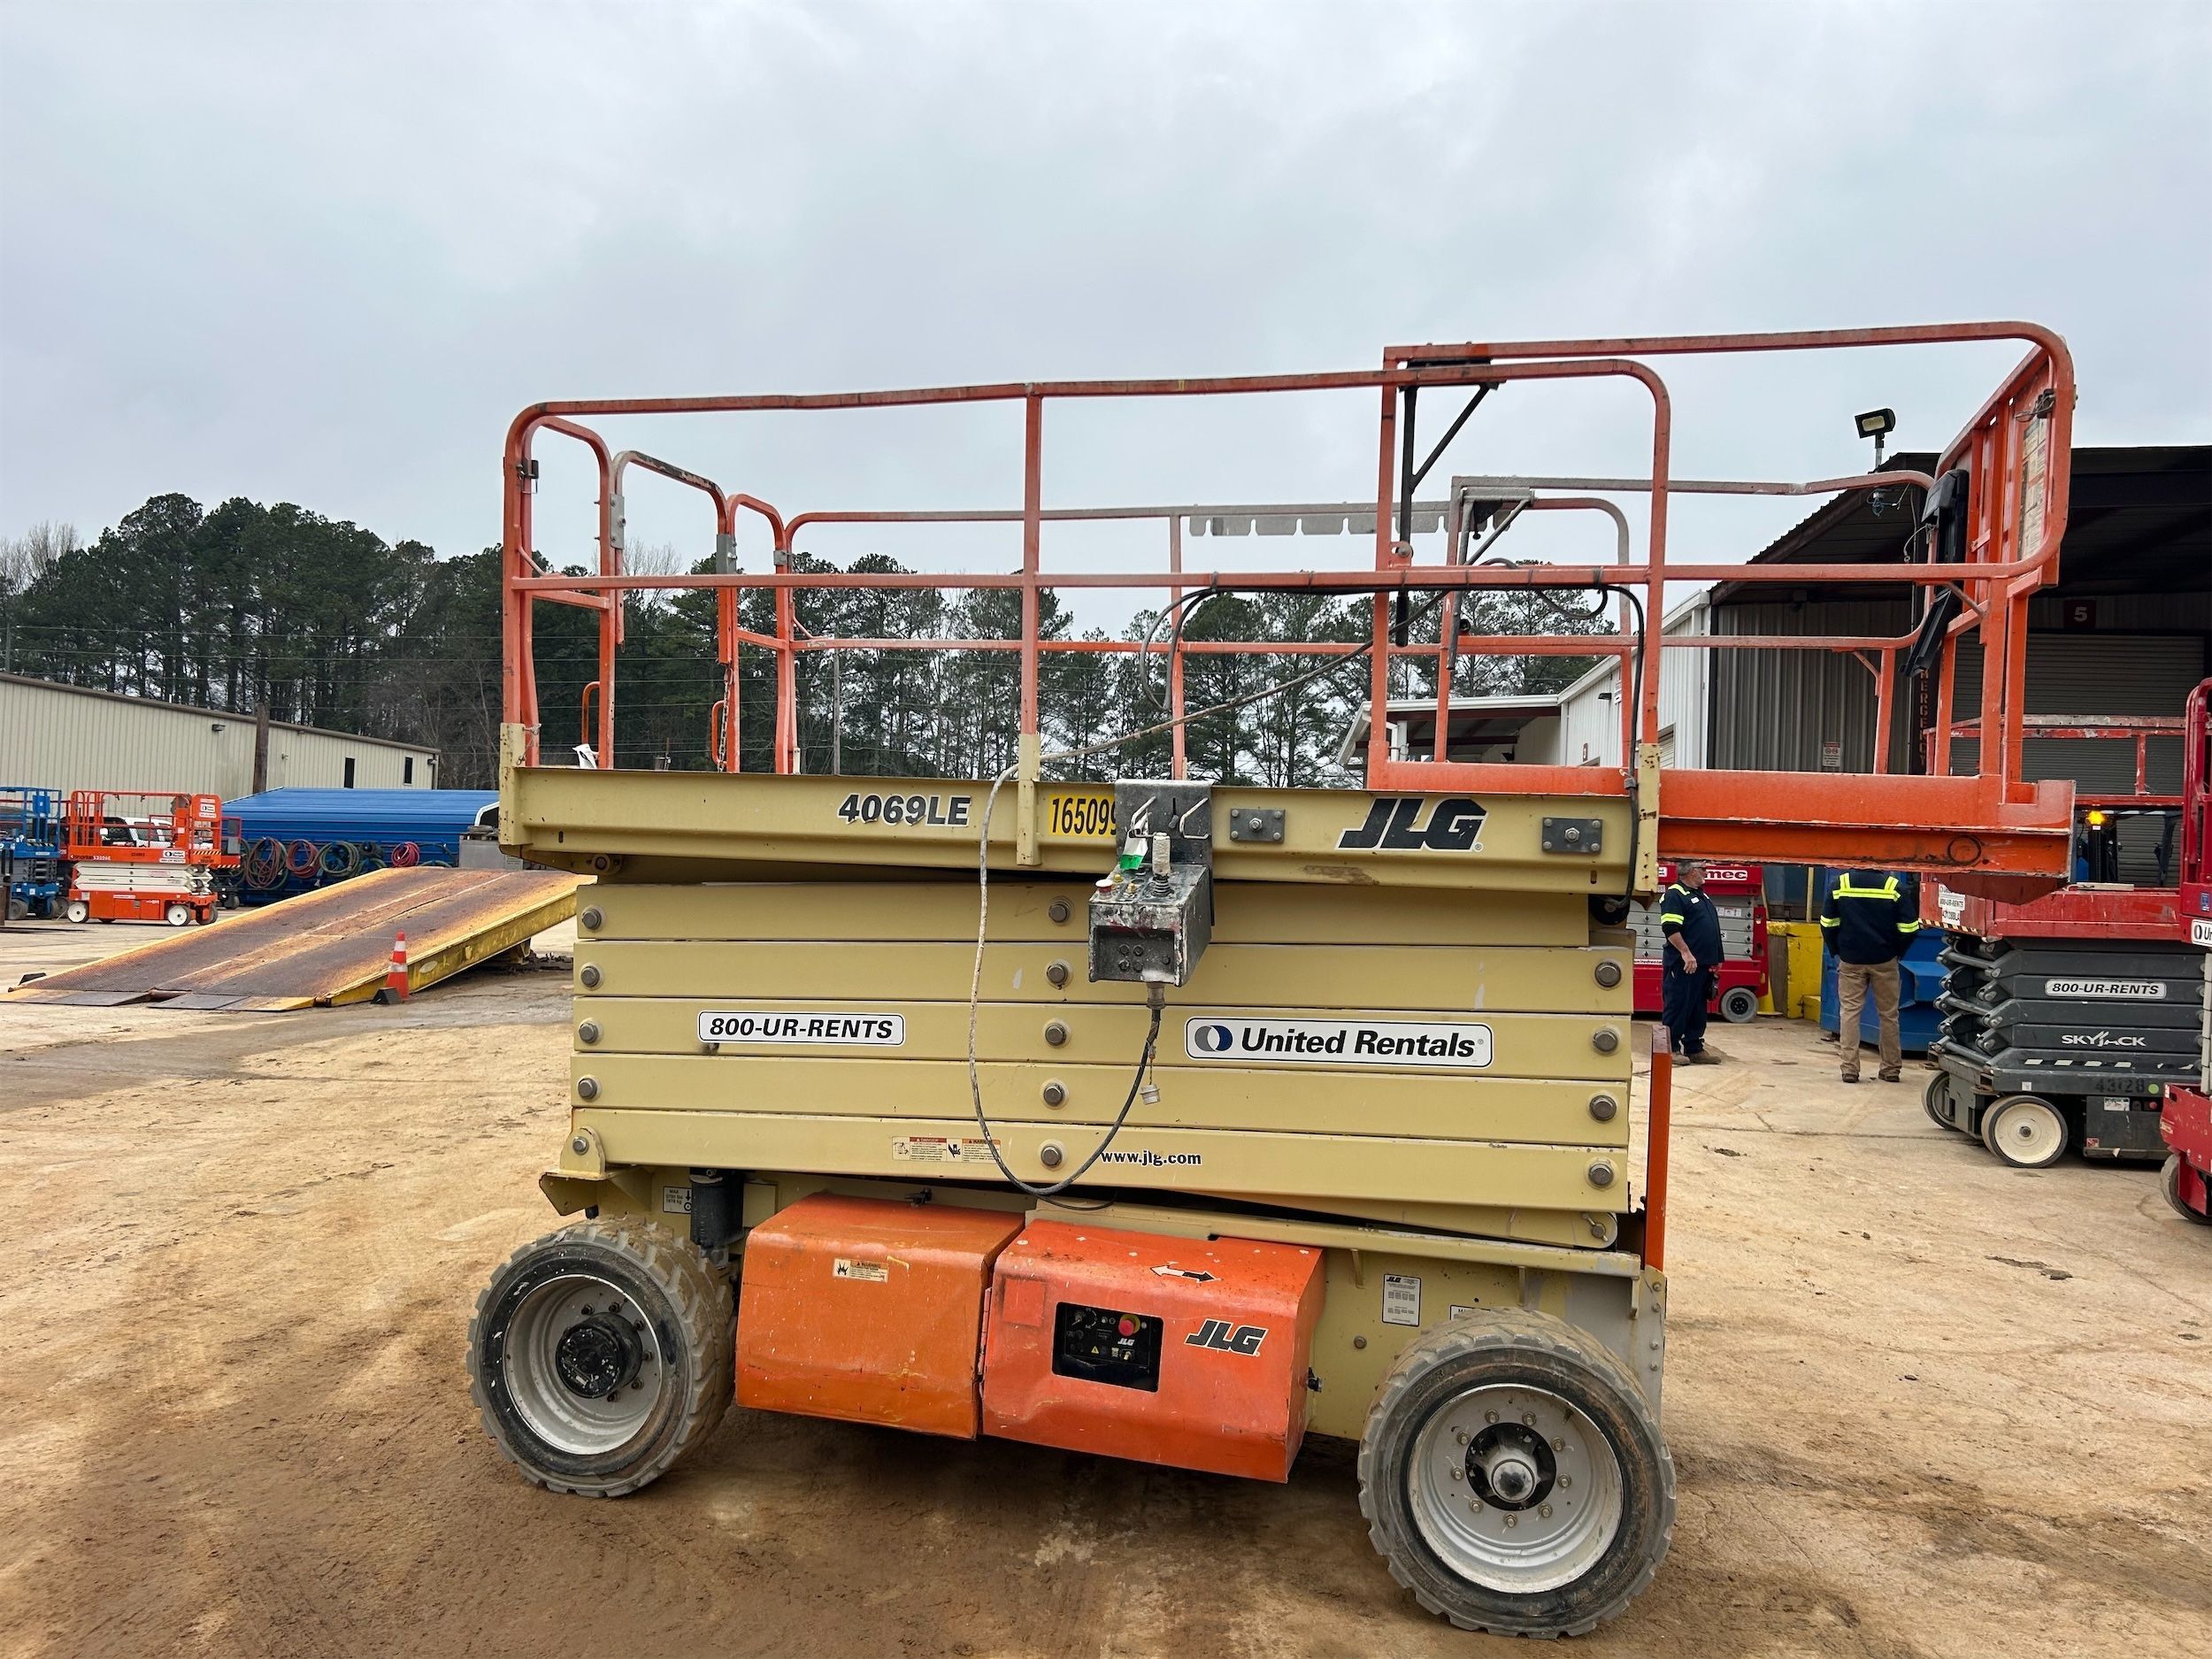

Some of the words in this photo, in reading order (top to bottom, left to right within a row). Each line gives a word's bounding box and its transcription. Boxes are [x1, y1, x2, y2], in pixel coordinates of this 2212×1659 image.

[2074, 606, 2088, 623] 5
[838, 794, 971, 827] 4069LE
[1337, 797, 1487, 850] JLG
[2052, 982, 2159, 995] 800-UR-RENTS
[710, 1018, 894, 1039] 800-UR-RENTS
[2062, 1031, 2147, 1047] SKYJACK
[1241, 1027, 1347, 1054] United
[1354, 1030, 1475, 1057] Rentals
[1100, 1150, 1202, 1167] www.jlg.com
[1185, 1318, 1269, 1357] JLG
